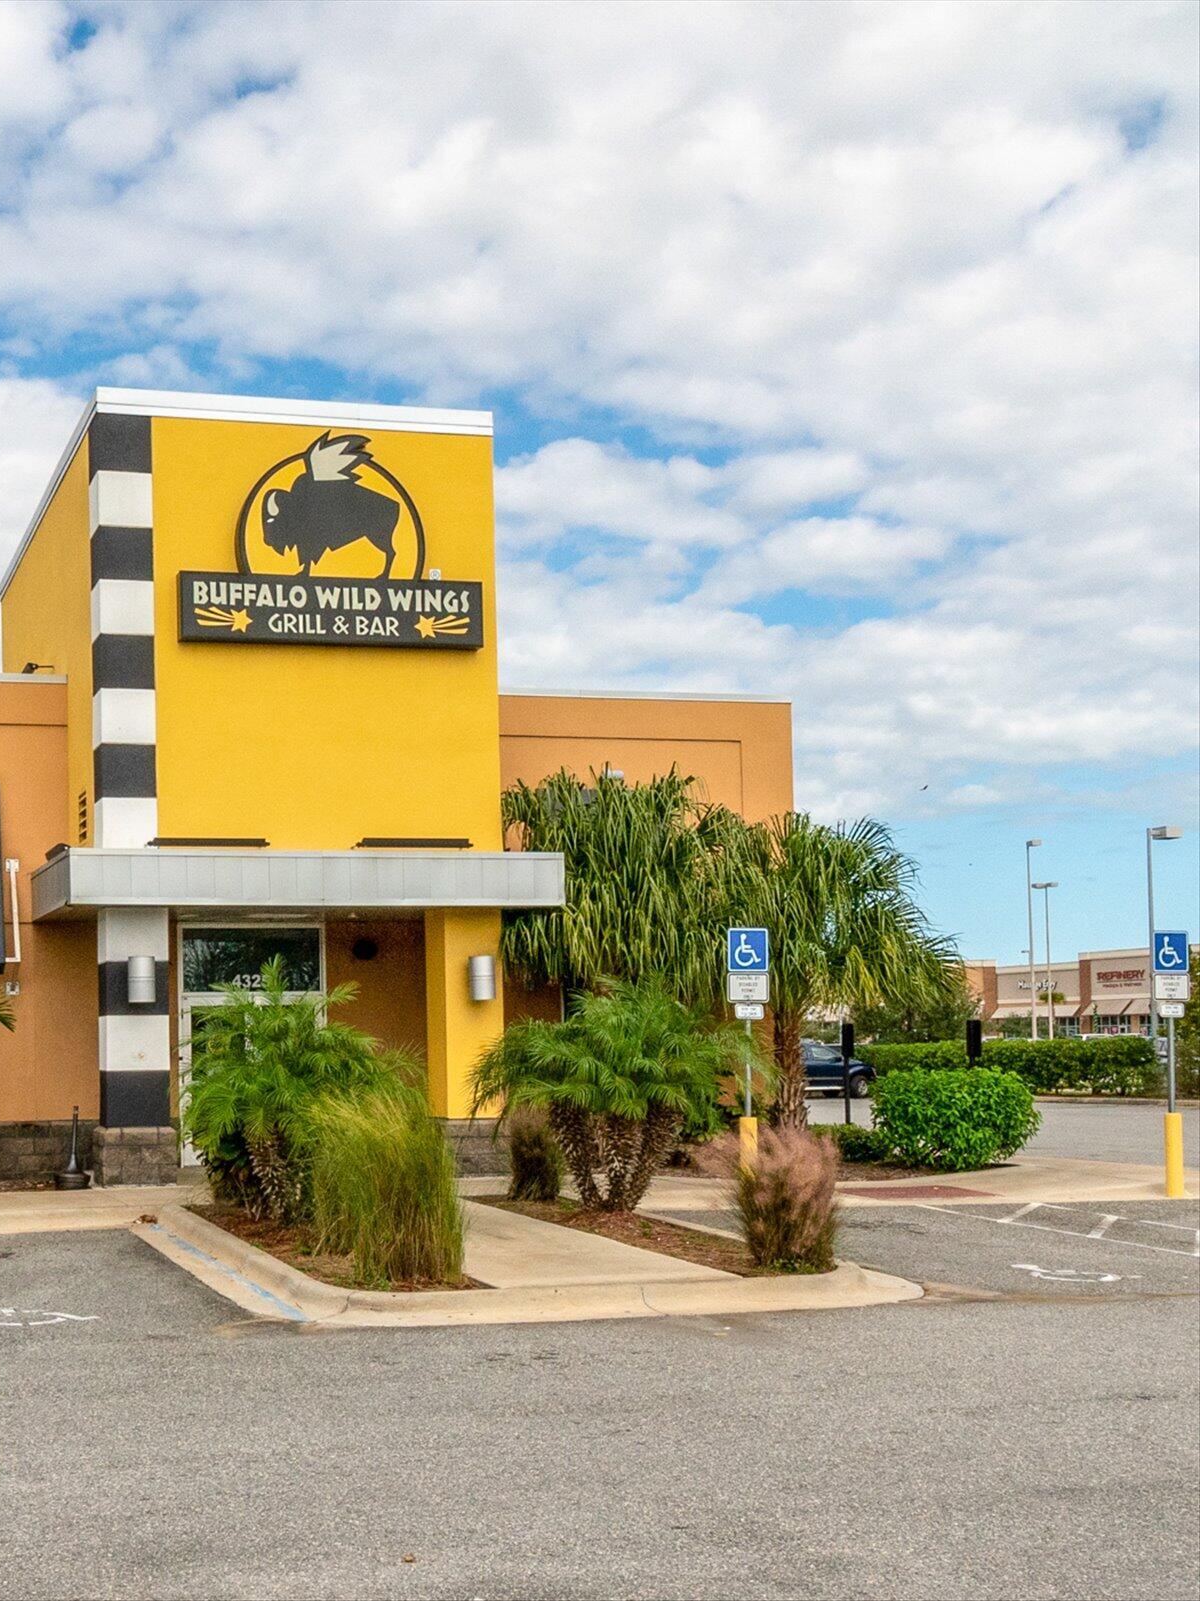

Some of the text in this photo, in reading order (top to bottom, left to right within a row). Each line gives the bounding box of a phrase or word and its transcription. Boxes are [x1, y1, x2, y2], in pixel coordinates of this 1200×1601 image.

[192, 580, 470, 613] BUFFALO WILD WINGS
[267, 612, 400, 637] GRILL & BAR
[231, 973, 269, 988] 432
